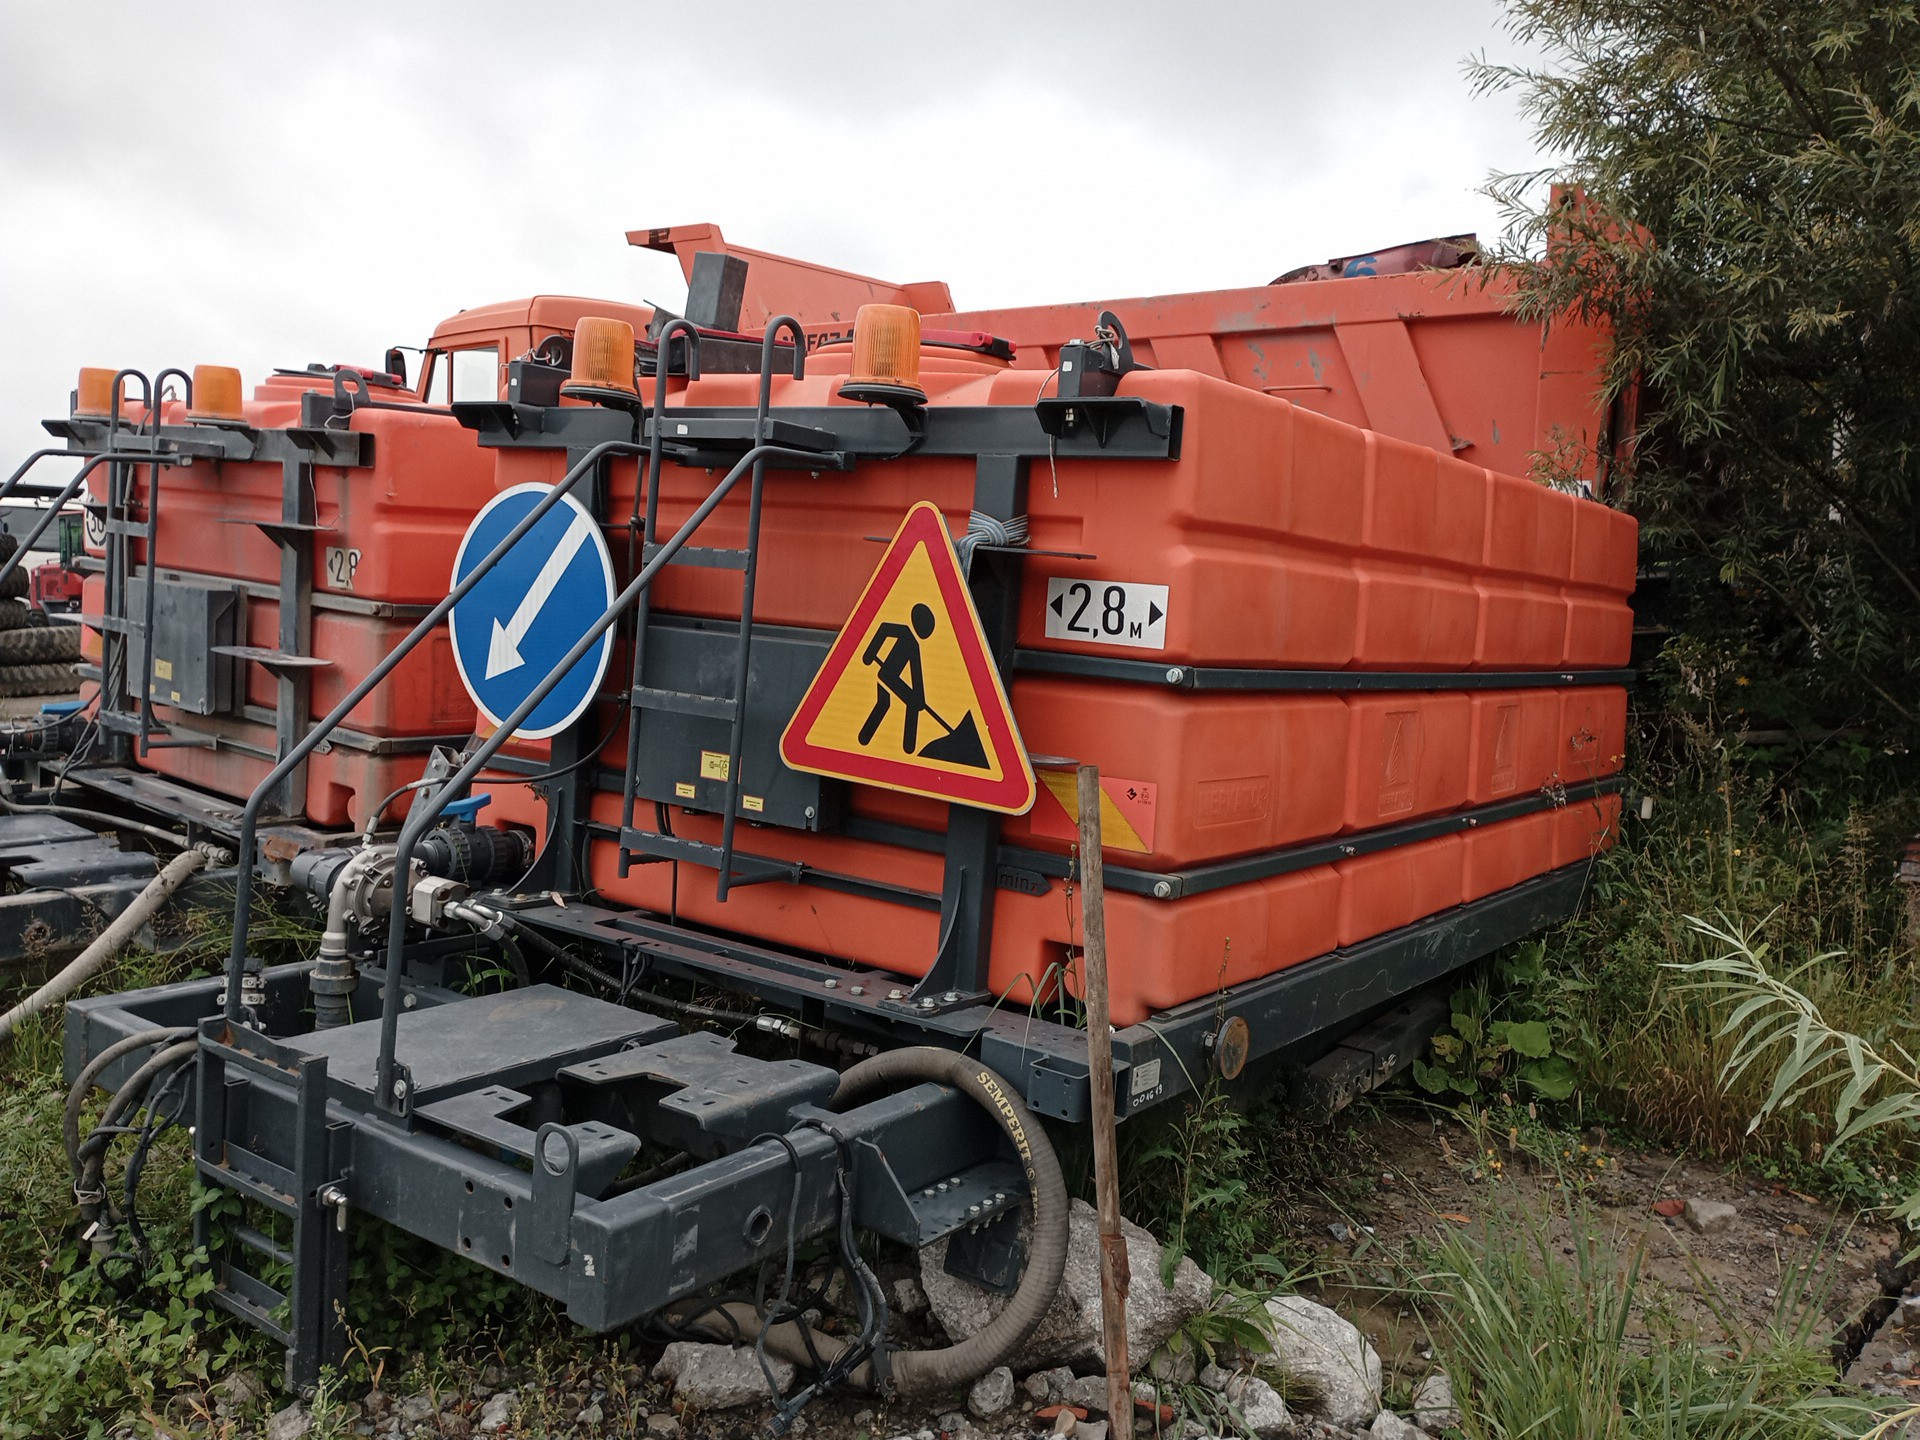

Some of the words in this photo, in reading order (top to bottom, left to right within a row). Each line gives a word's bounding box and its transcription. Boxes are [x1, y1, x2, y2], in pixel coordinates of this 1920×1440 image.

[1067, 583, 1126, 639] 2,8
[1000, 872, 1029, 891] min
[976, 1071, 1032, 1161] SEMPERIT
